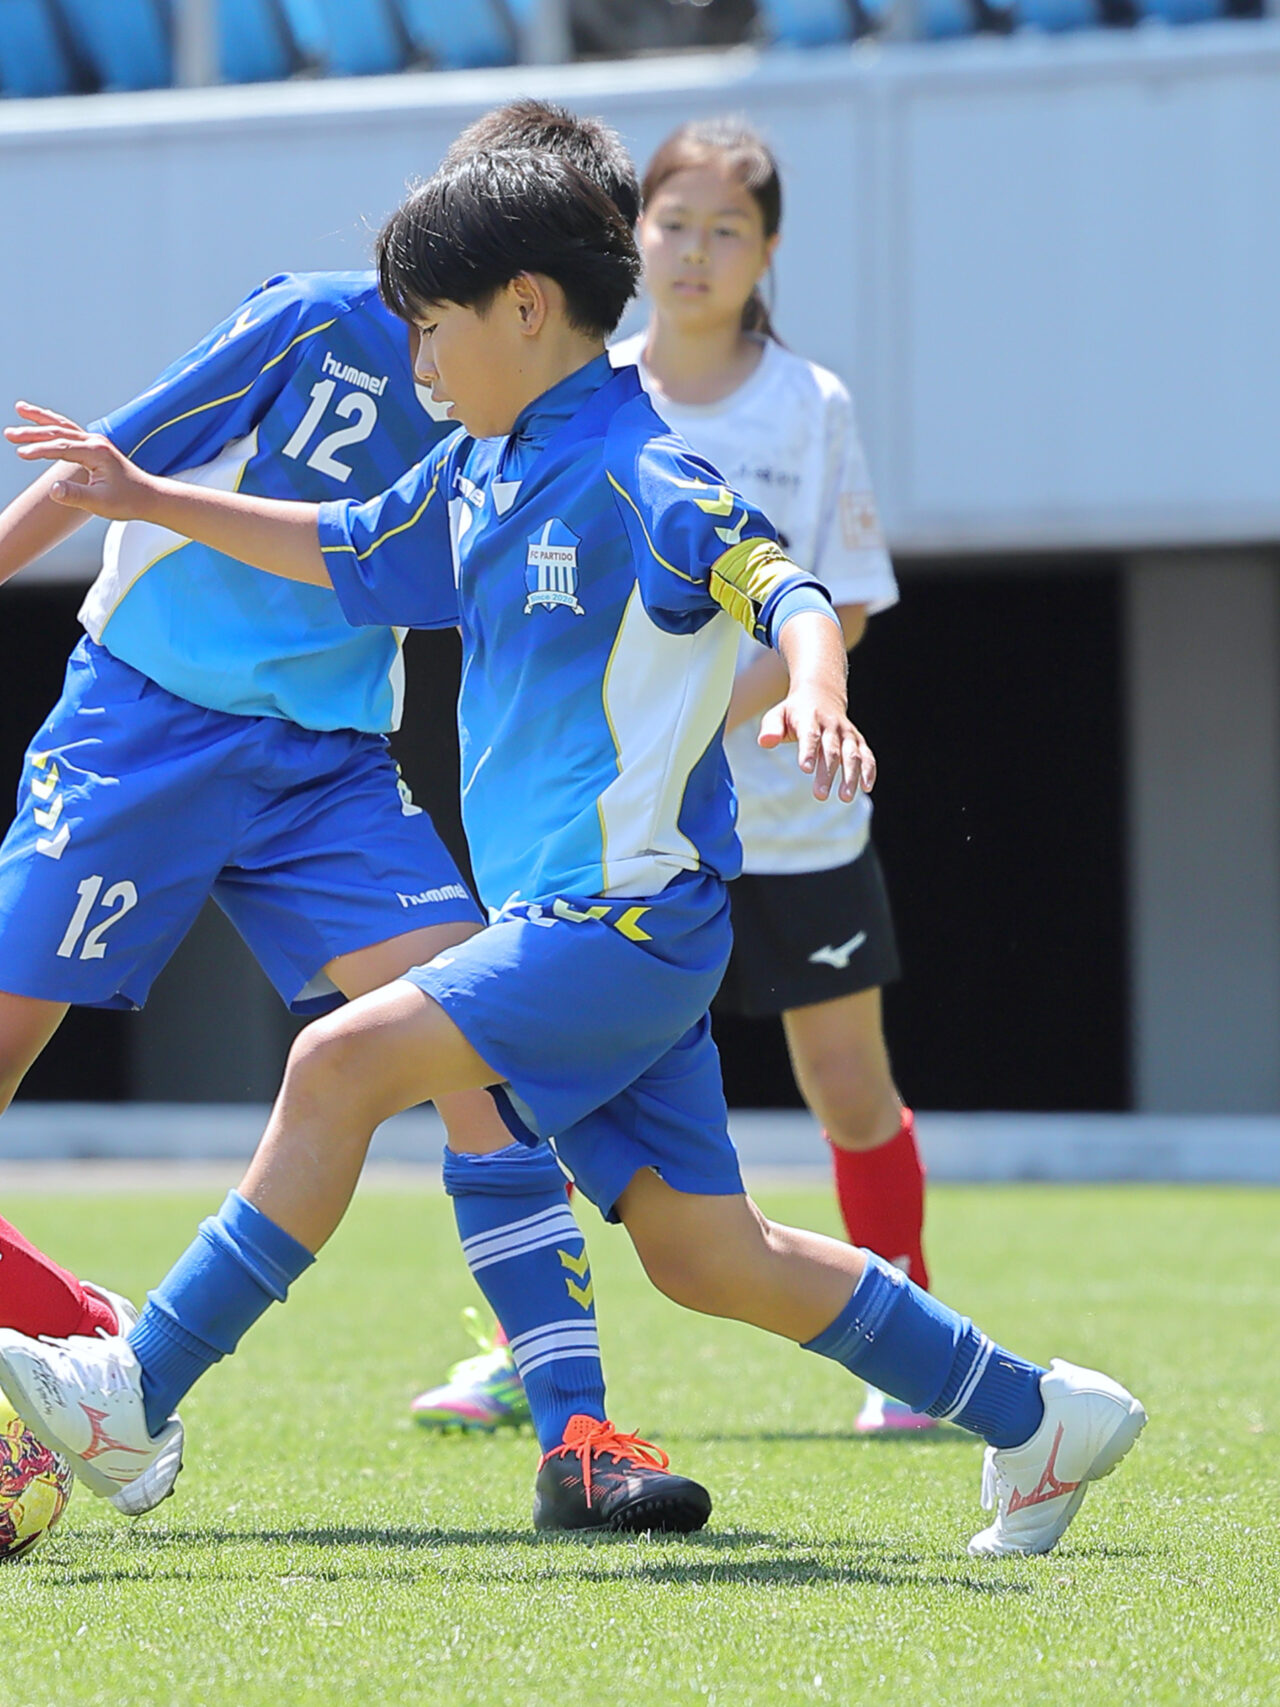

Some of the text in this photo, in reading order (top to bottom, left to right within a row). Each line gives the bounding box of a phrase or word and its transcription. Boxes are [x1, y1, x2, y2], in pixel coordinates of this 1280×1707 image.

[322, 352, 388, 396] hummel
[281, 379, 378, 483] 12
[530, 550, 573, 561] FC PARTIDO
[56, 874, 138, 960] 12
